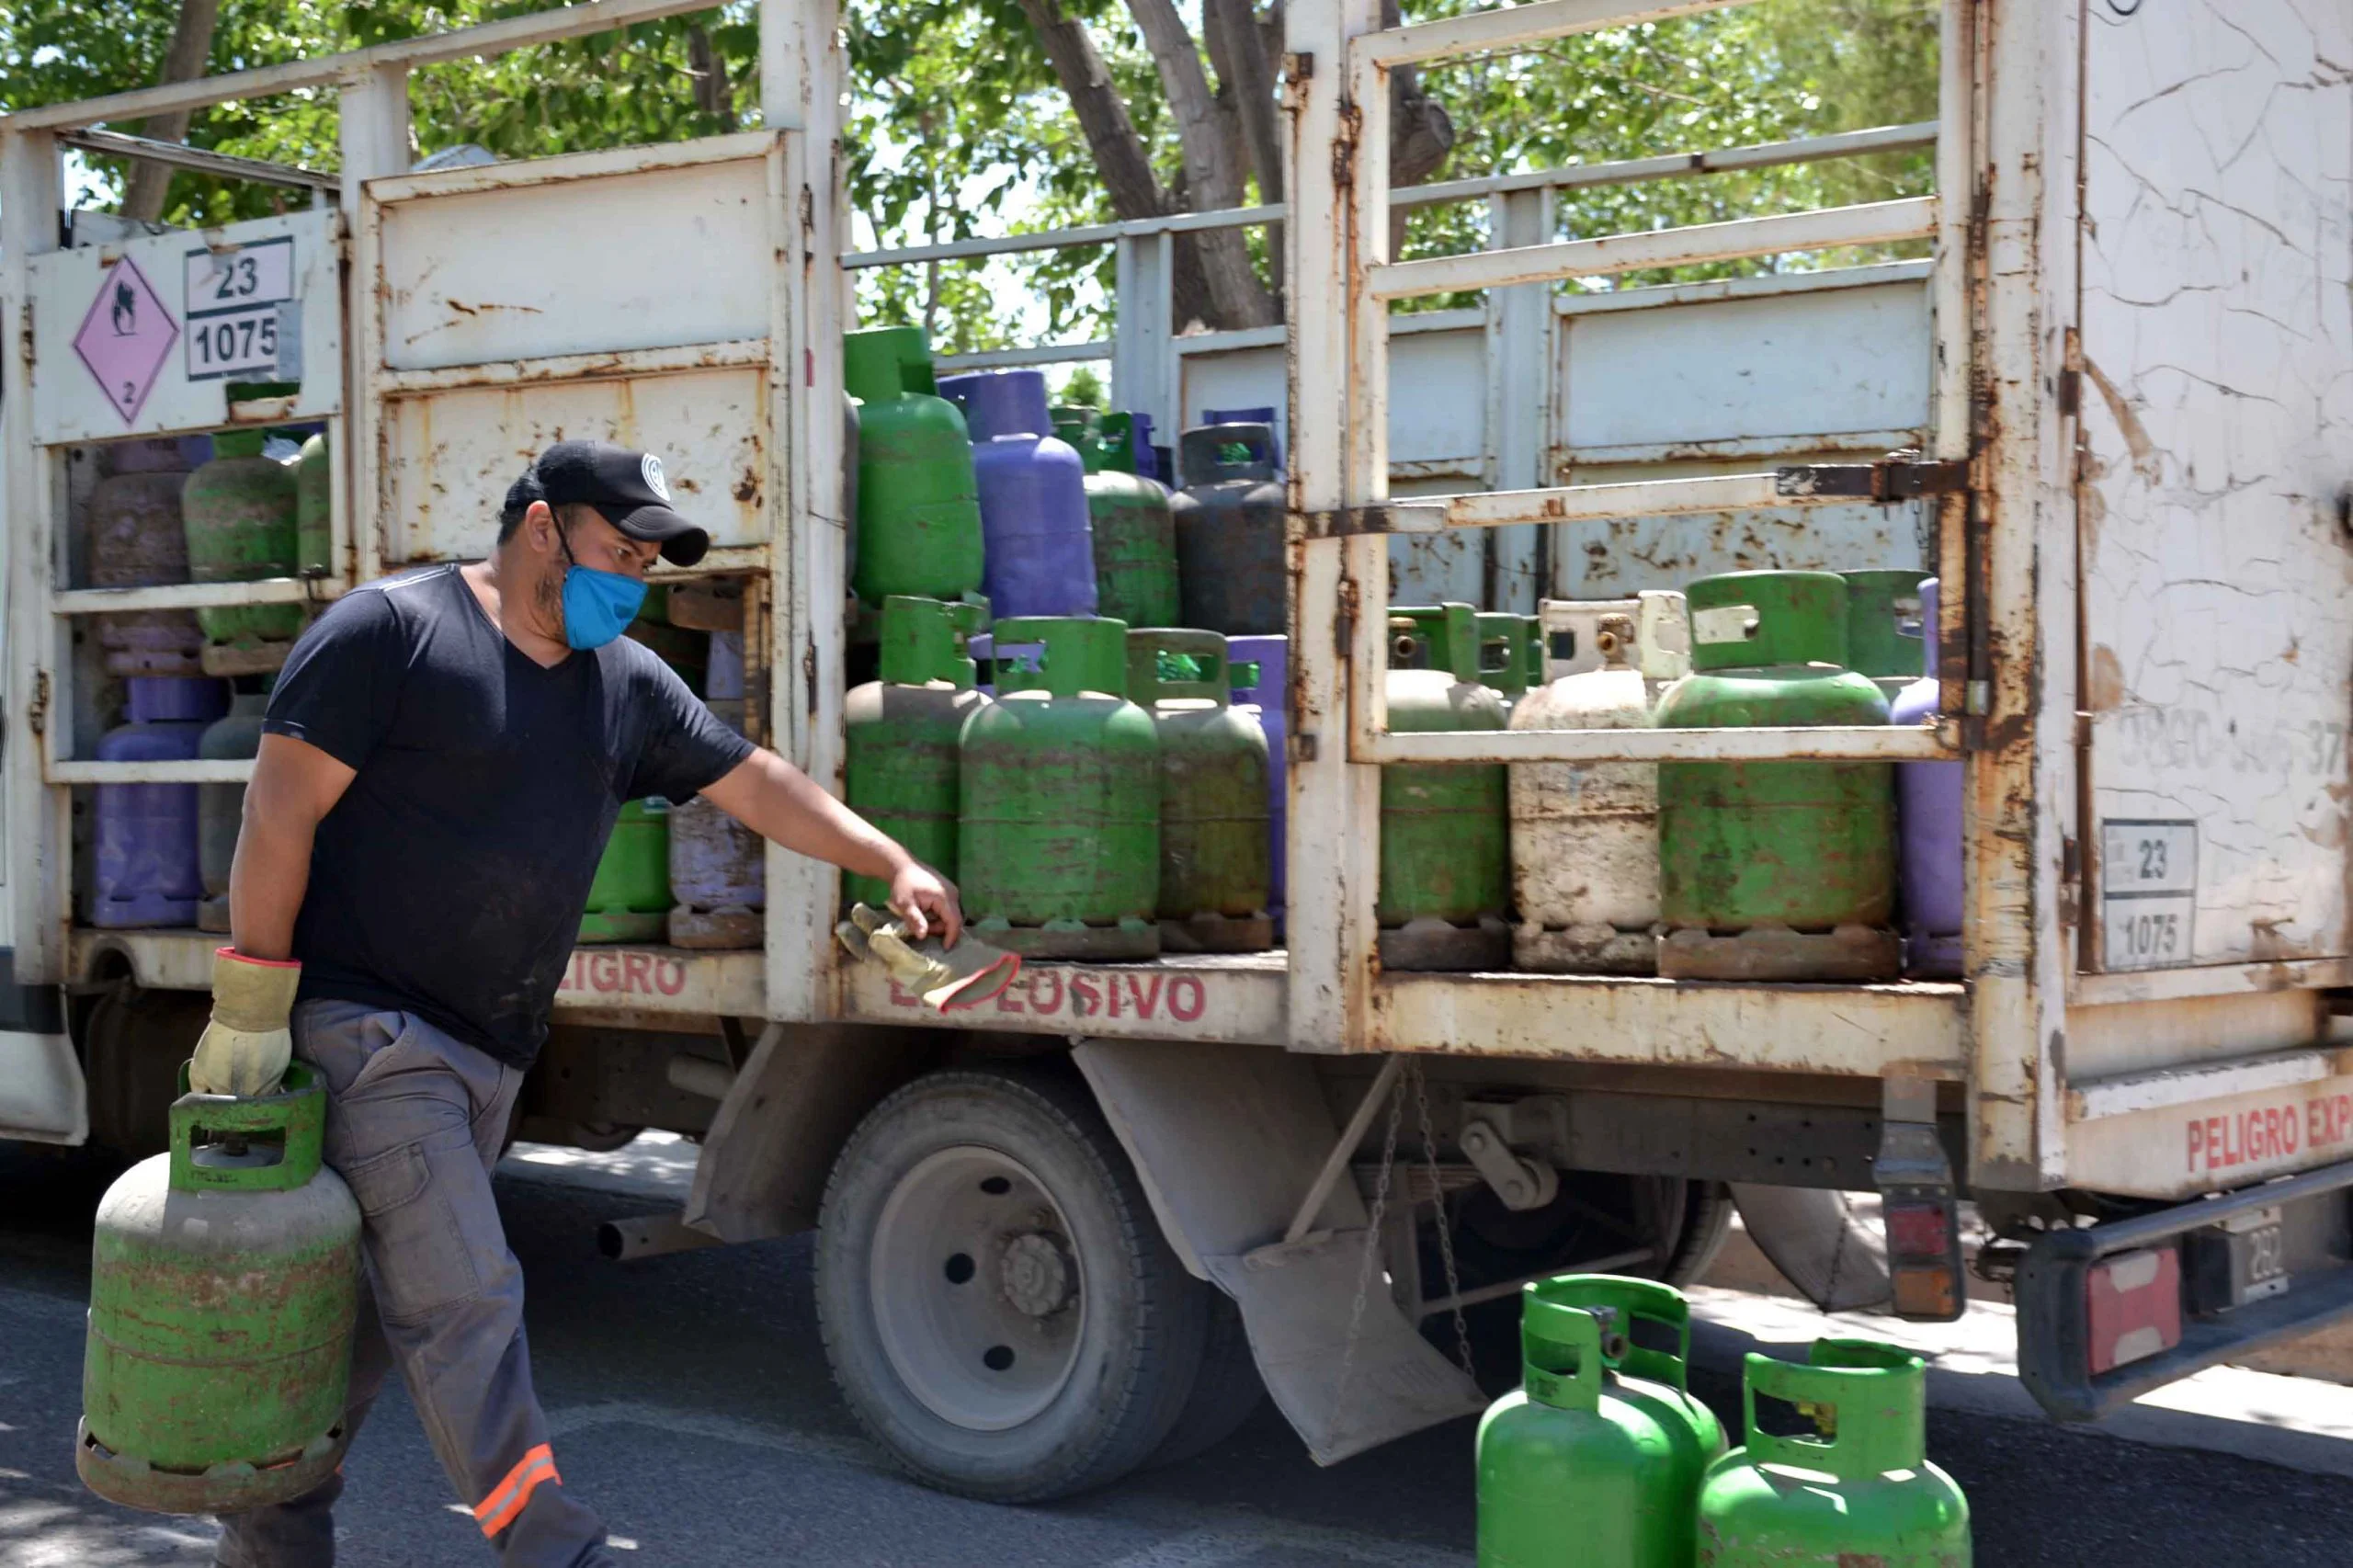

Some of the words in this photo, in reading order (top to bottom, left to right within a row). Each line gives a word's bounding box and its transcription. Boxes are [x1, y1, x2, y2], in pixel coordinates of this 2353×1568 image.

[216, 257, 257, 299] 23
[196, 318, 276, 363] 1075
[122, 381, 136, 404] 2
[2139, 839, 2167, 879] 23
[2125, 914, 2177, 955] 1075
[559, 953, 686, 995] IGRO
[889, 969, 1206, 1022] ELOSIVO
[2187, 1105, 2297, 1173] PELIGRO
